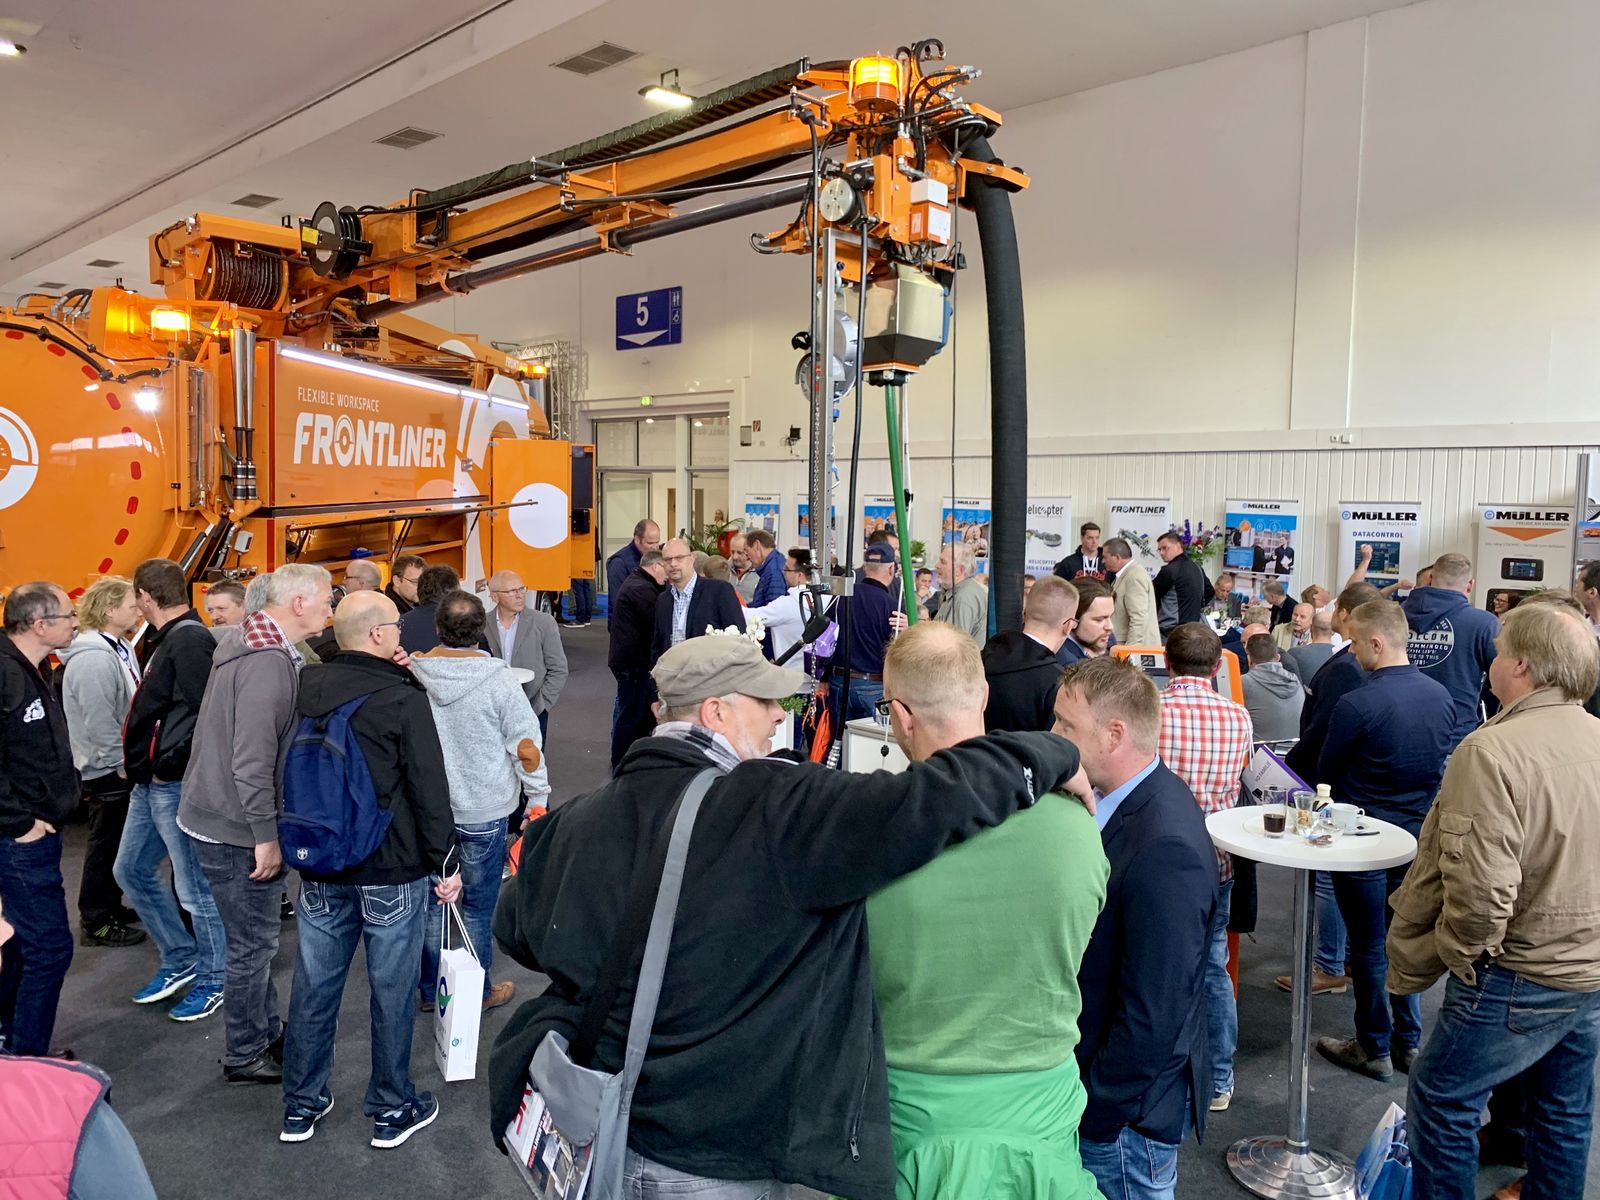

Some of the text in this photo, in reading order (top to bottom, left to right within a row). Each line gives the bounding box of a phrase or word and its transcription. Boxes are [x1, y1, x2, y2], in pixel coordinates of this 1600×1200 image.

[636, 296, 649, 327] 5
[297, 386, 380, 412] FLEXIBLE WORKSPACE
[293, 411, 447, 468] FRONTLINER
[1111, 505, 1166, 514] FRONTLINER
[1352, 511, 1417, 521] MÜLLER
[1496, 511, 1570, 522] MÜLLER
